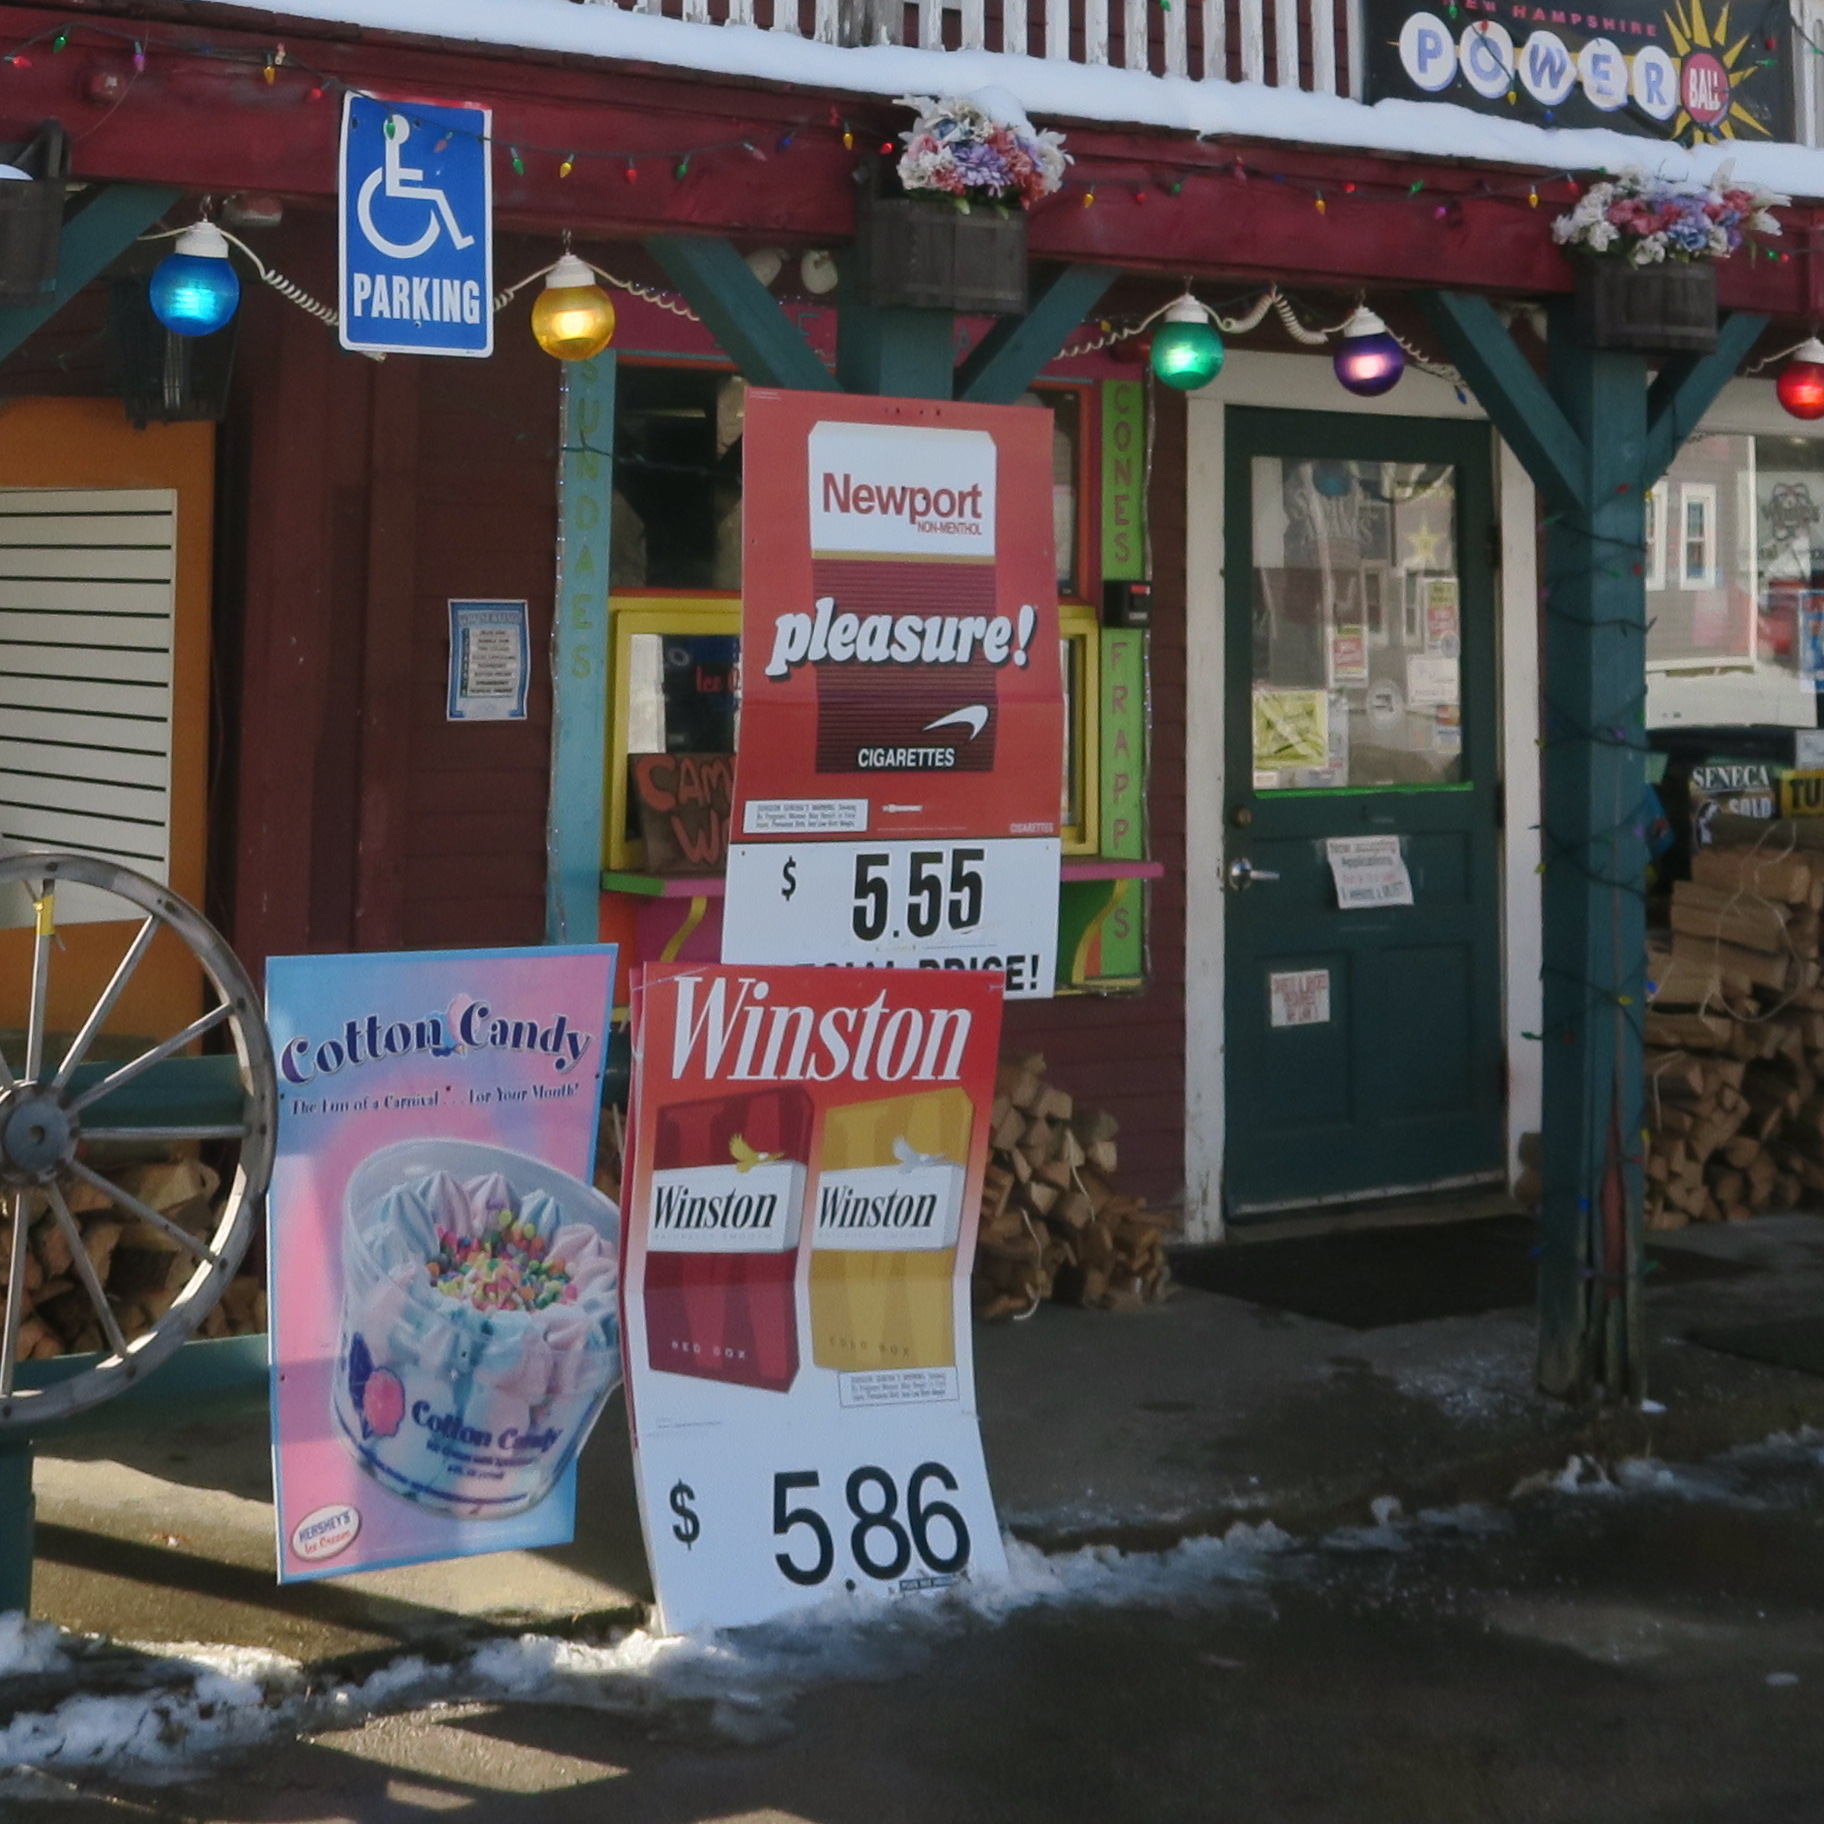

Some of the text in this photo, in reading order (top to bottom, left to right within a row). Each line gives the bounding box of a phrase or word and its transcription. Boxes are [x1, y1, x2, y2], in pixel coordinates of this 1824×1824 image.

[1512, 5, 1658, 38] HAMPSHIRE
[1415, 27, 1668, 107] POWER
[352, 272, 481, 325] PARKING
[822, 472, 983, 525] Newport
[1112, 383, 1133, 564] CONES
[917, 520, 983, 536] NON-MENTHOL
[764, 596, 1036, 679] pleasure!
[634, 753, 737, 812] CAM
[857, 747, 956, 769] CIGARETTES
[781, 848, 985, 942] $ 5.55
[279, 1000, 595, 1084] Cotton Candy
[669, 975, 973, 1084] Winston
[292, 1098, 317, 1115] The
[354, 1094, 371, 1112] of
[384, 1091, 440, 1111] Carnival
[468, 1088, 492, 1105] For
[495, 1086, 528, 1104] Your
[653, 1184, 938, 1229] Winston Winston
[668, 1462, 972, 1593] $ 5.86
